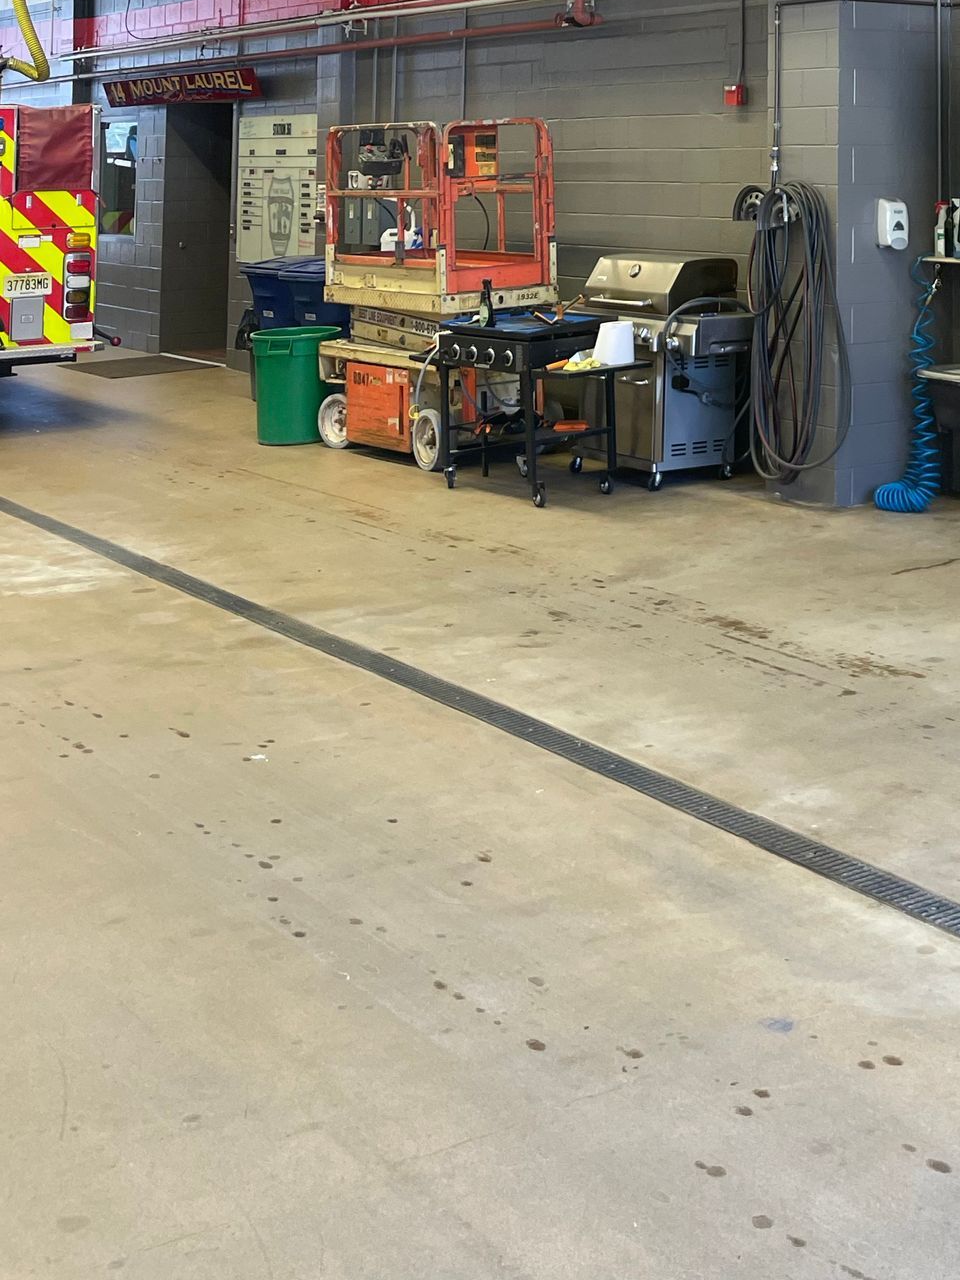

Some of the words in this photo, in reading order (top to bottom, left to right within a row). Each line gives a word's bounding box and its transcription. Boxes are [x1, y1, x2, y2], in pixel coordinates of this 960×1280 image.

[129, 76, 180, 98] MOUNT
[184, 70, 252, 91] LAUREL
[7, 278, 49, 291] 37783MG
